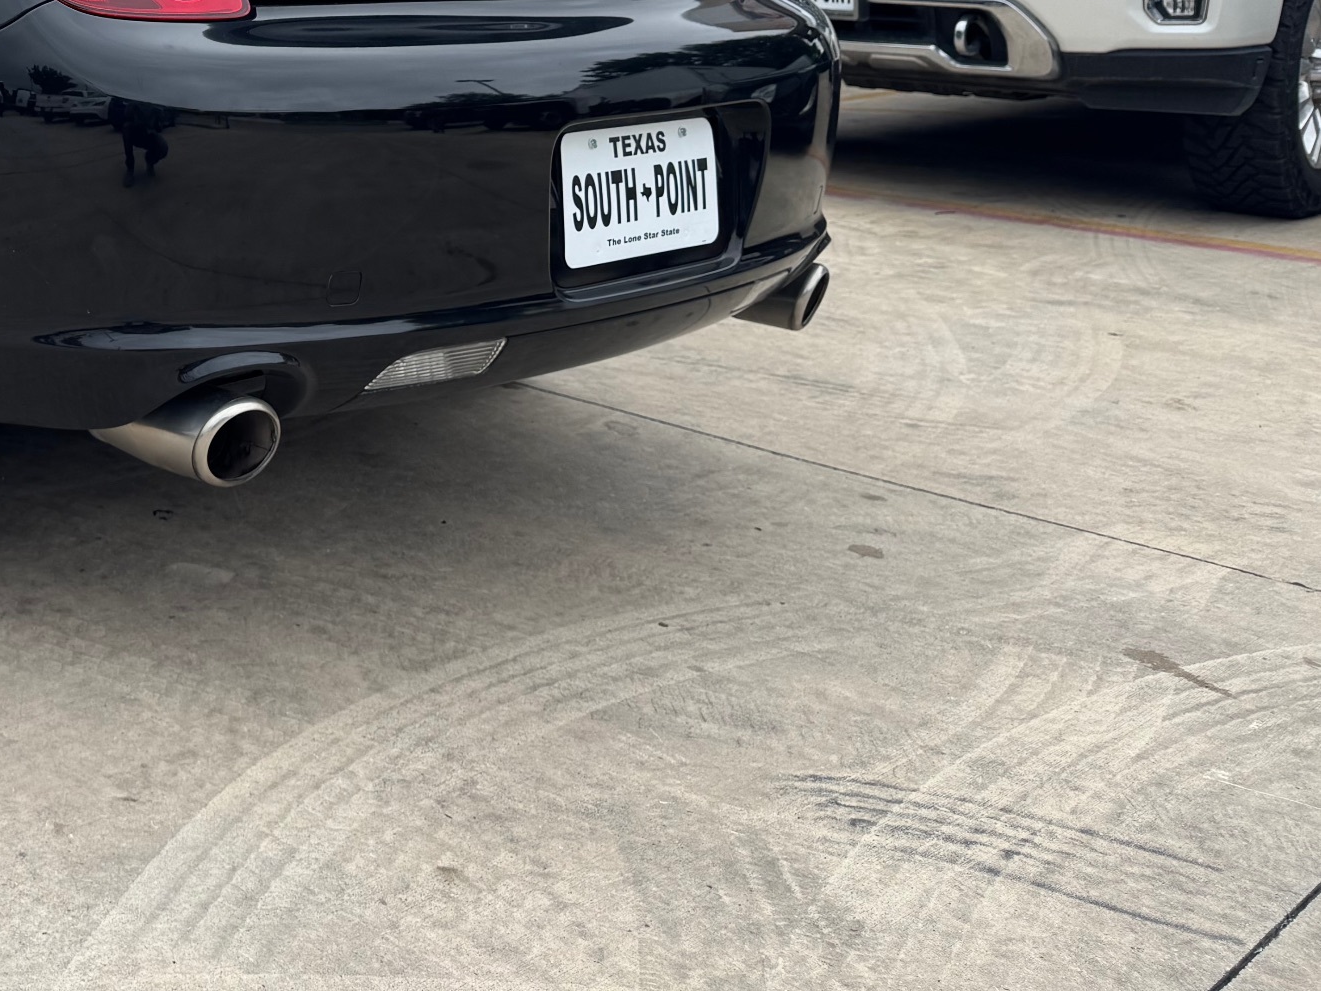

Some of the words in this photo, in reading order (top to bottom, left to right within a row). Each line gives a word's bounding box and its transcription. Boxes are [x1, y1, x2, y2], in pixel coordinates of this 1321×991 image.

[609, 130, 667, 158] TEXAS
[572, 167, 638, 232] SOUTH
[653, 157, 708, 218] POINT
[607, 238, 622, 247] The
[623, 235, 642, 244] Lone
[643, 231, 659, 240] Star
[661, 228, 680, 237] State
